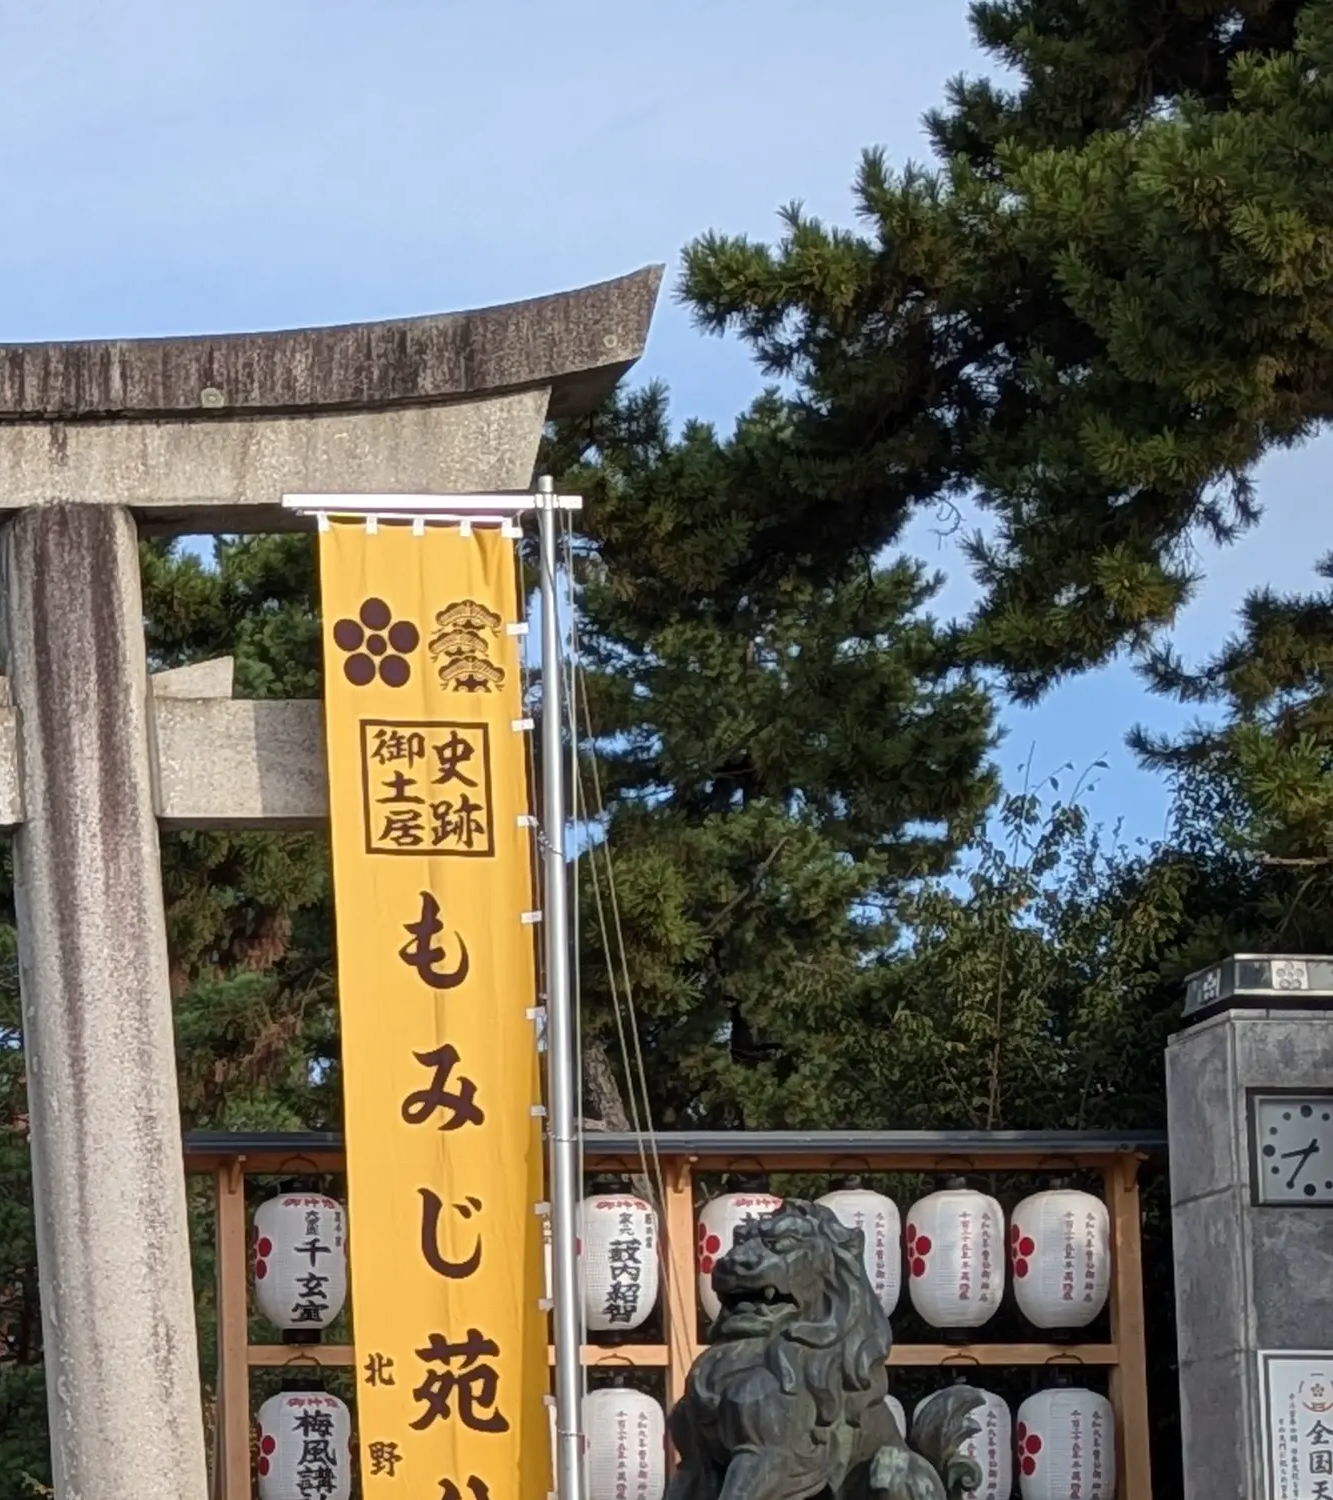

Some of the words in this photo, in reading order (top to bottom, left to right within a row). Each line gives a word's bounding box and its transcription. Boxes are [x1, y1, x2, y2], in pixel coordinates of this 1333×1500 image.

[370, 728, 426, 848] 御土居
[432, 730, 486, 849] 史跡
[291, 1238, 332, 1322] 千玄室
[874, 1212, 886, 1303] 令和九年菅公御神
